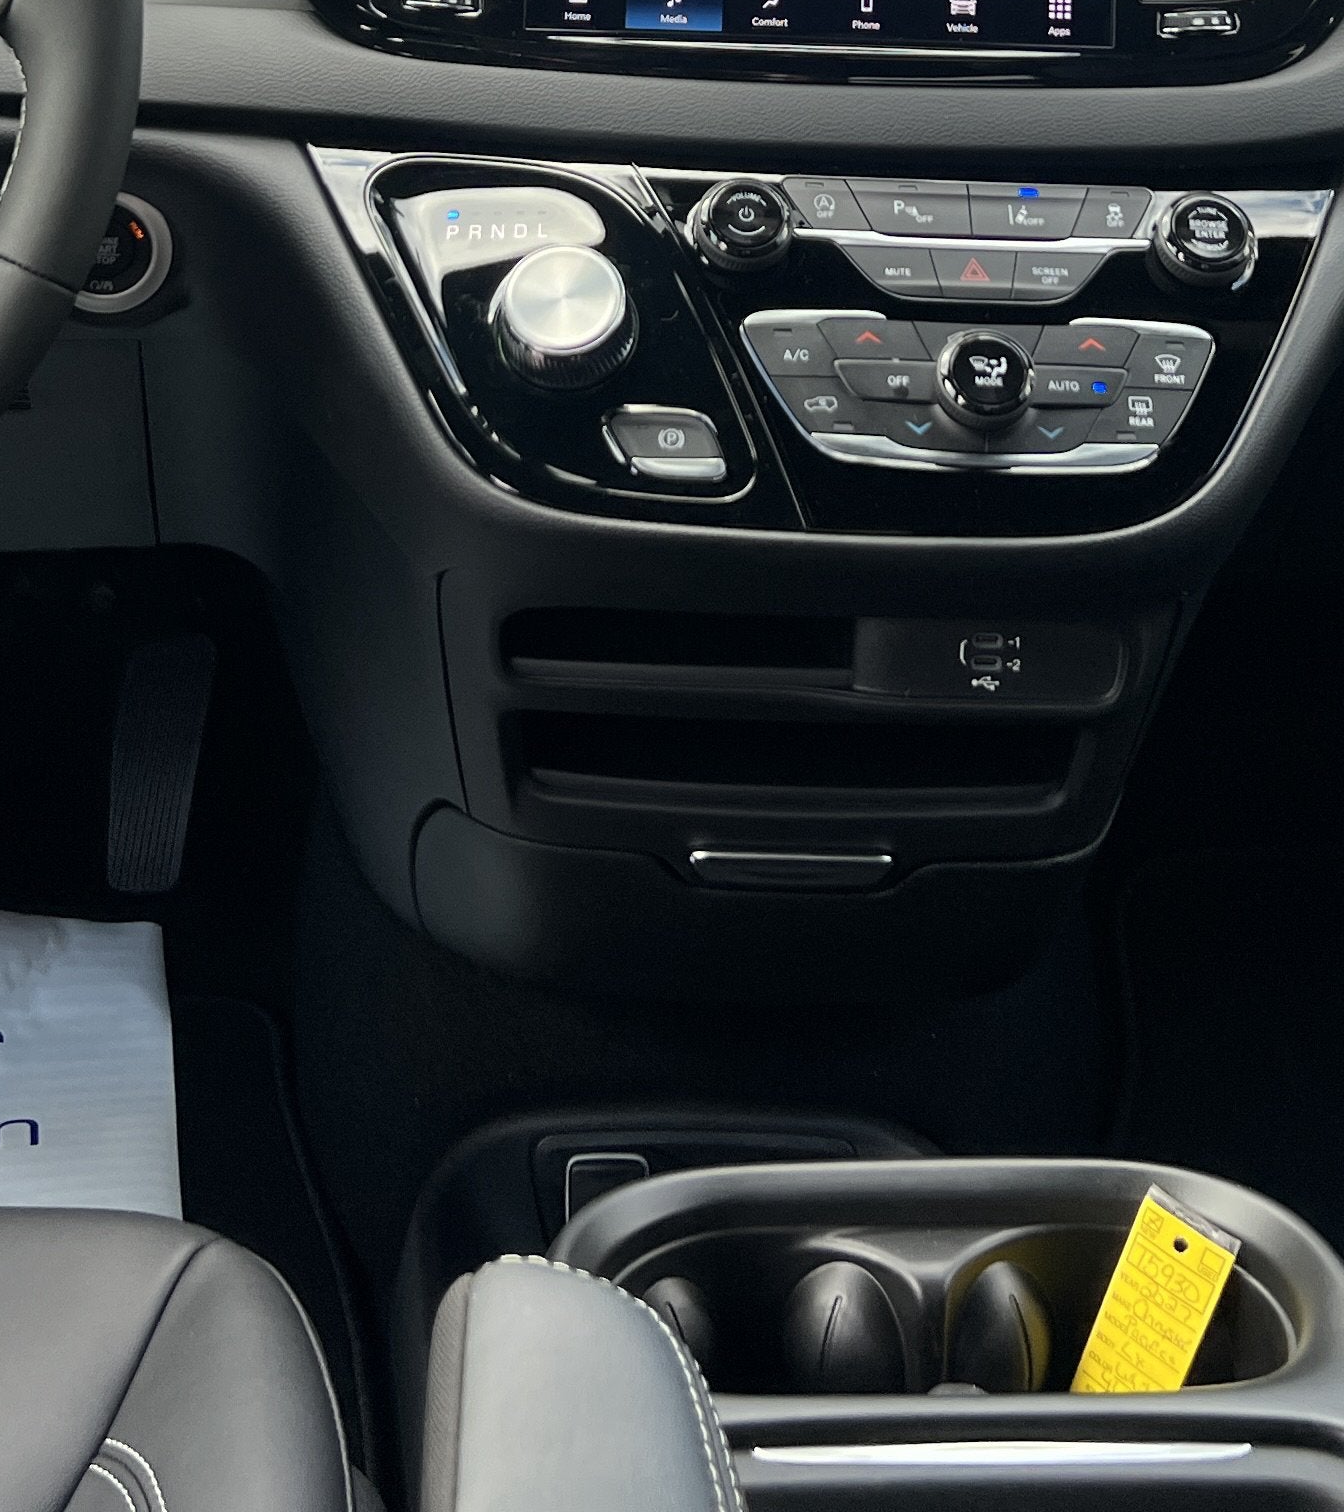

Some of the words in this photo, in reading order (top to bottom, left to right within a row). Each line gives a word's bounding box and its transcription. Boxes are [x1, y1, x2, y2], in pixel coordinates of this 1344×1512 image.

[564, 11, 592, 22] Home
[660, 14, 688, 24] Media
[751, 17, 788, 28] Comfort
[852, 20, 881, 31] Phone
[946, 22, 979, 34] Vehicle
[1047, 25, 1071, 38] Apps
[730, 191, 762, 203] VOLUME
[893, 199, 905, 215] P
[816, 210, 834, 218] OFF
[915, 214, 934, 224] OFF
[1027, 217, 1045, 226] OFF
[1106, 219, 1125, 228] OFF
[446, 225, 459, 239] P
[468, 224, 482, 239] R
[490, 224, 505, 239] N
[514, 223, 528, 238] D
[537, 222, 548, 238] L
[884, 267, 912, 277] MUTE
[1032, 267, 1069, 277] SCREEN
[1041, 276, 1060, 285] OFF
[783, 348, 809, 362] A/C
[887, 375, 910, 386] OFF
[974, 376, 1004, 387] MODE
[1154, 374, 1186, 385] FRONT
[1047, 380, 1080, 392] AUTO
[1128, 417, 1154, 427] REAR
